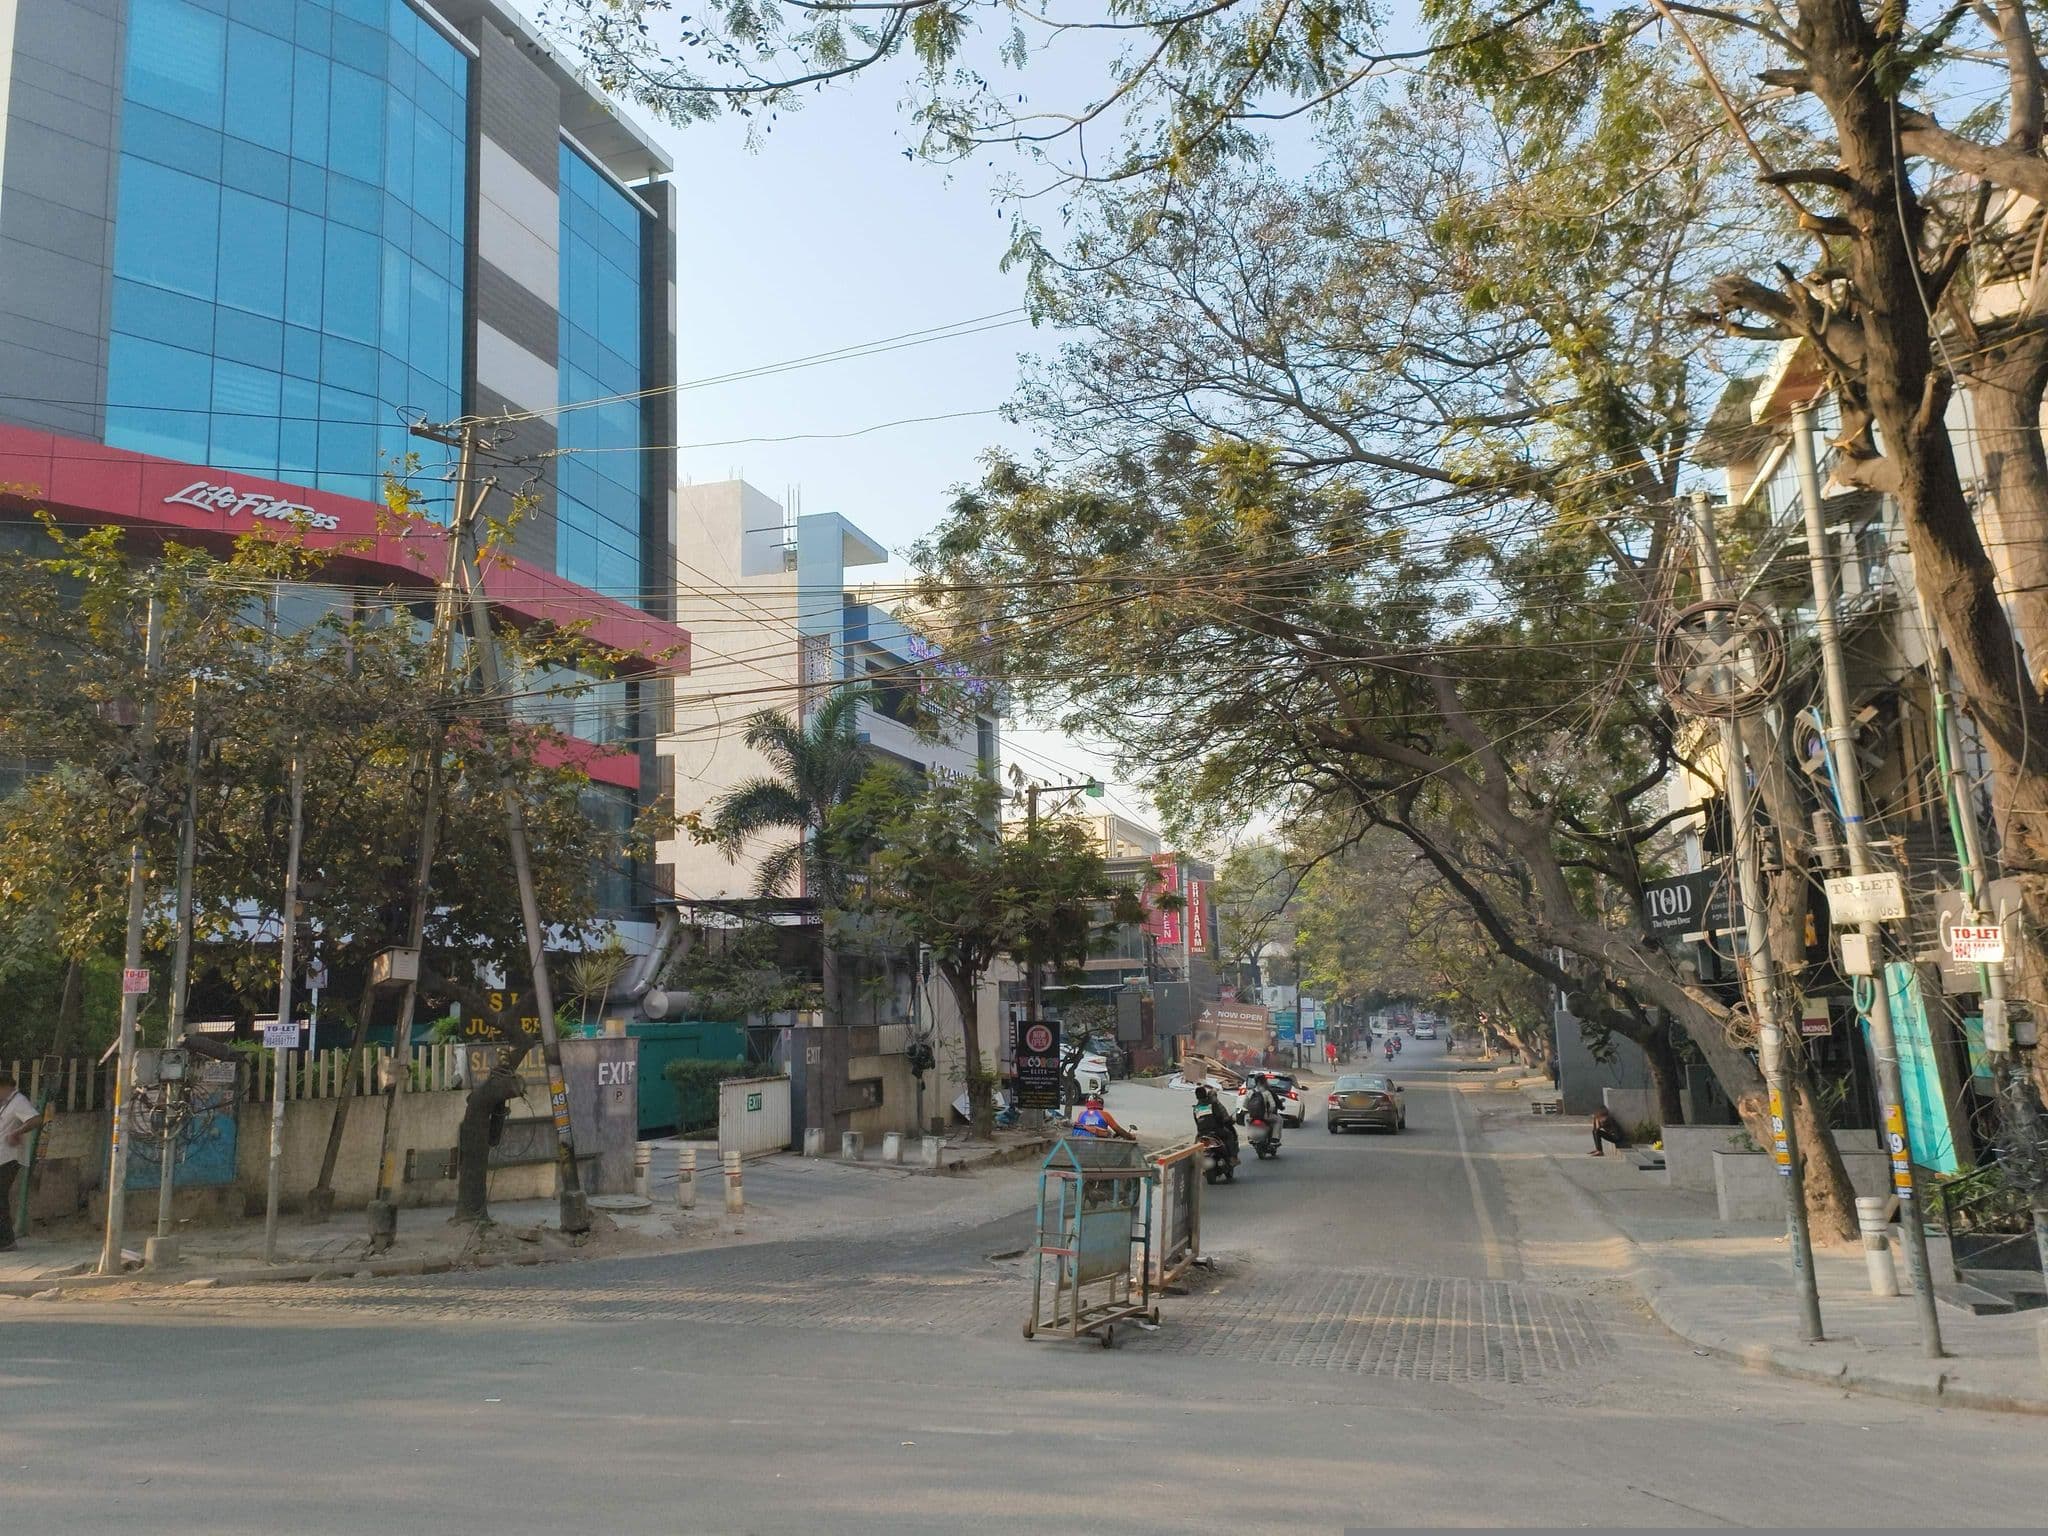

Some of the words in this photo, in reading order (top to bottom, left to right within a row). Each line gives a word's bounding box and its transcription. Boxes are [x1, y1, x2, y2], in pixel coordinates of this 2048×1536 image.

[1830, 879, 1895, 895] TO-LET
[1646, 884, 1692, 917] TOD
[1952, 928, 1999, 939] TO-LET
[1216, 1010, 1239, 1019] NOW
[1240, 1013, 1263, 1021] OPEN
[598, 1061, 635, 1086] EXIT
